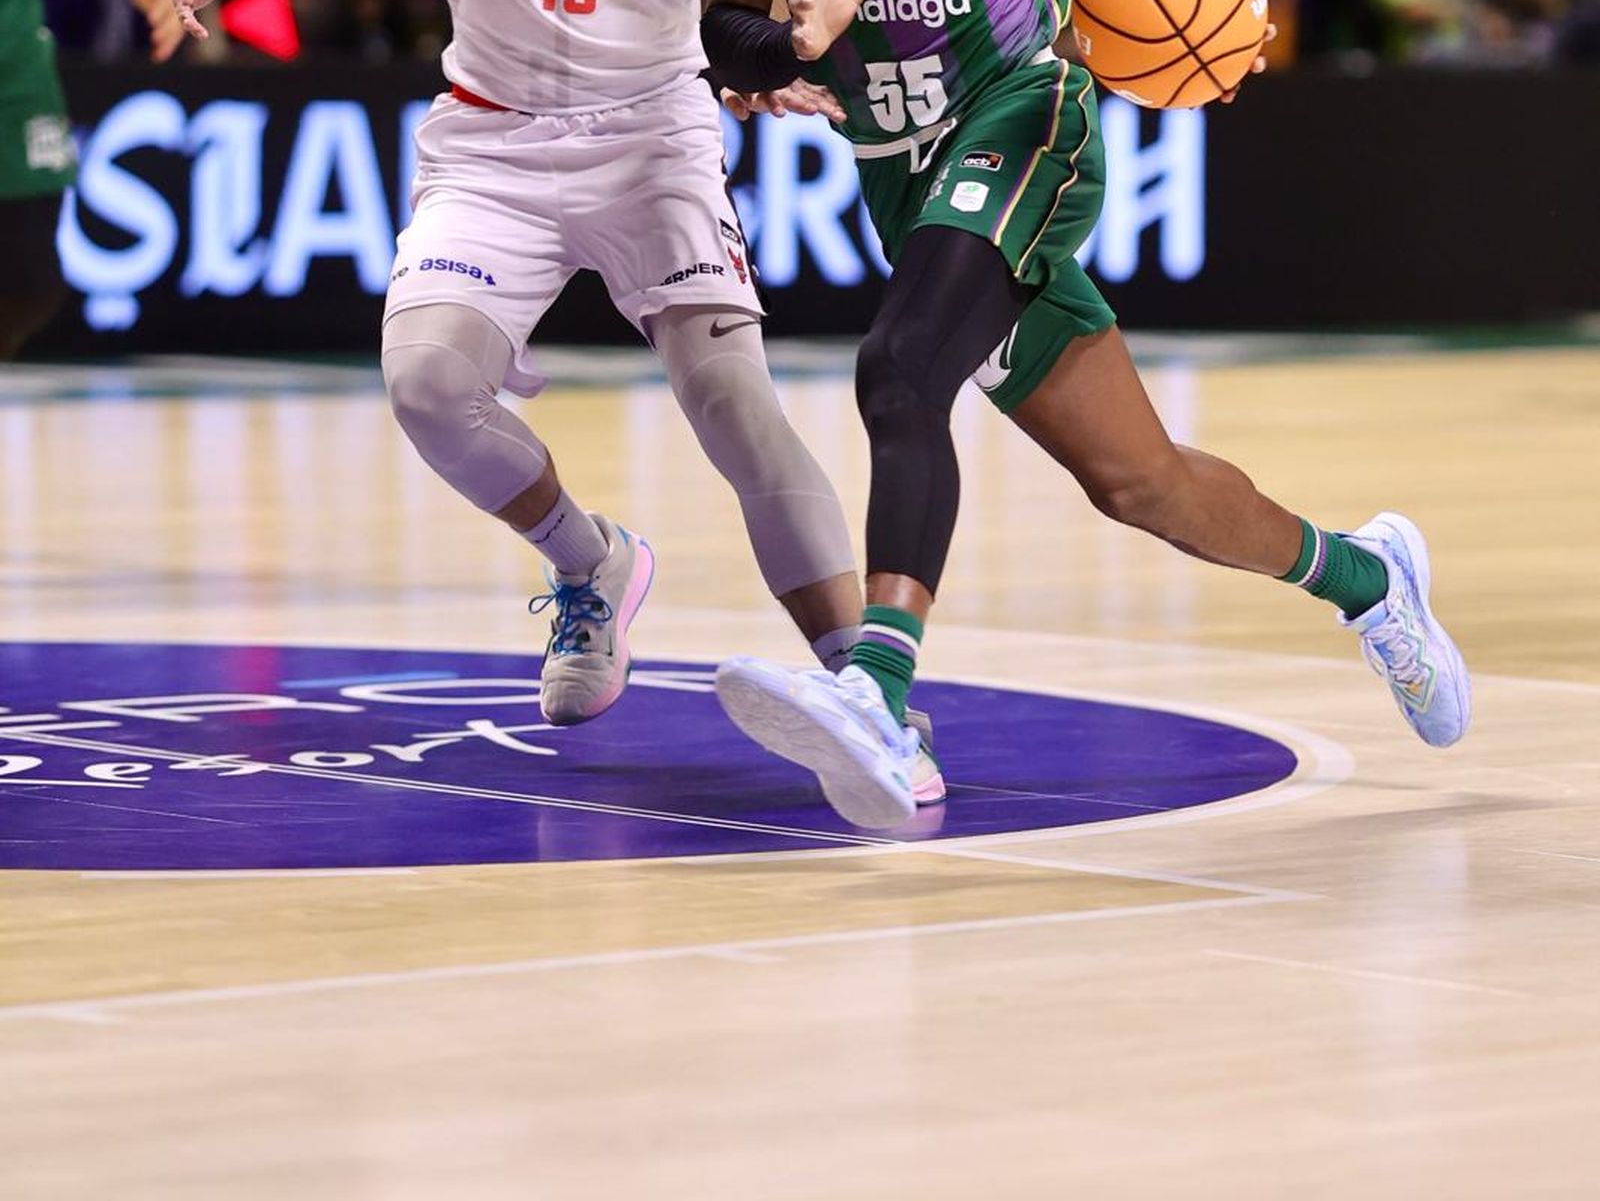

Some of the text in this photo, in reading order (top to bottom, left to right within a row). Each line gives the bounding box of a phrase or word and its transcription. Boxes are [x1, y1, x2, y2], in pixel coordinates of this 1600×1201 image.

[864, 54, 949, 133] 55
[963, 157, 991, 167] acb
[419, 258, 483, 280] asisa
[660, 262, 725, 286] ERNER
